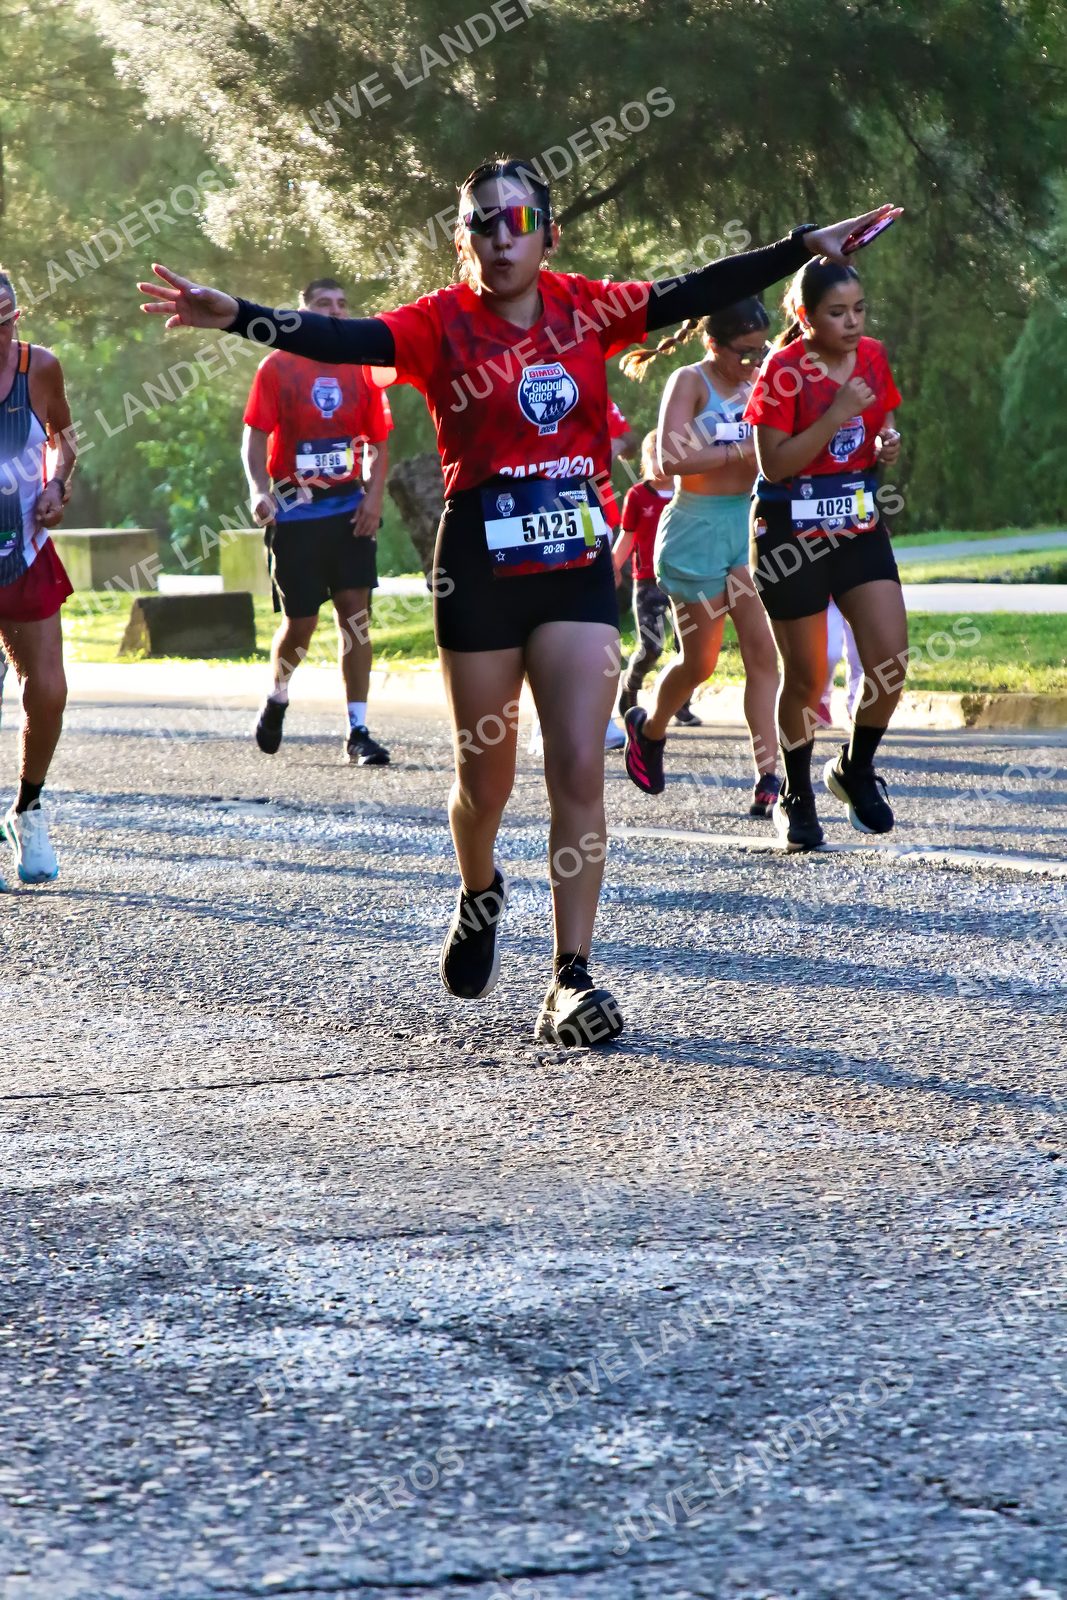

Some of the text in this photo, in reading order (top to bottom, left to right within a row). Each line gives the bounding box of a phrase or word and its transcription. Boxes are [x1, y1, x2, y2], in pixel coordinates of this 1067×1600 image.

[529, 368, 560, 378] BIMBO
[532, 379, 562, 393] Global
[528, 391, 552, 403] Race
[816, 497, 852, 517] 4029
[521, 511, 578, 542] 5425
